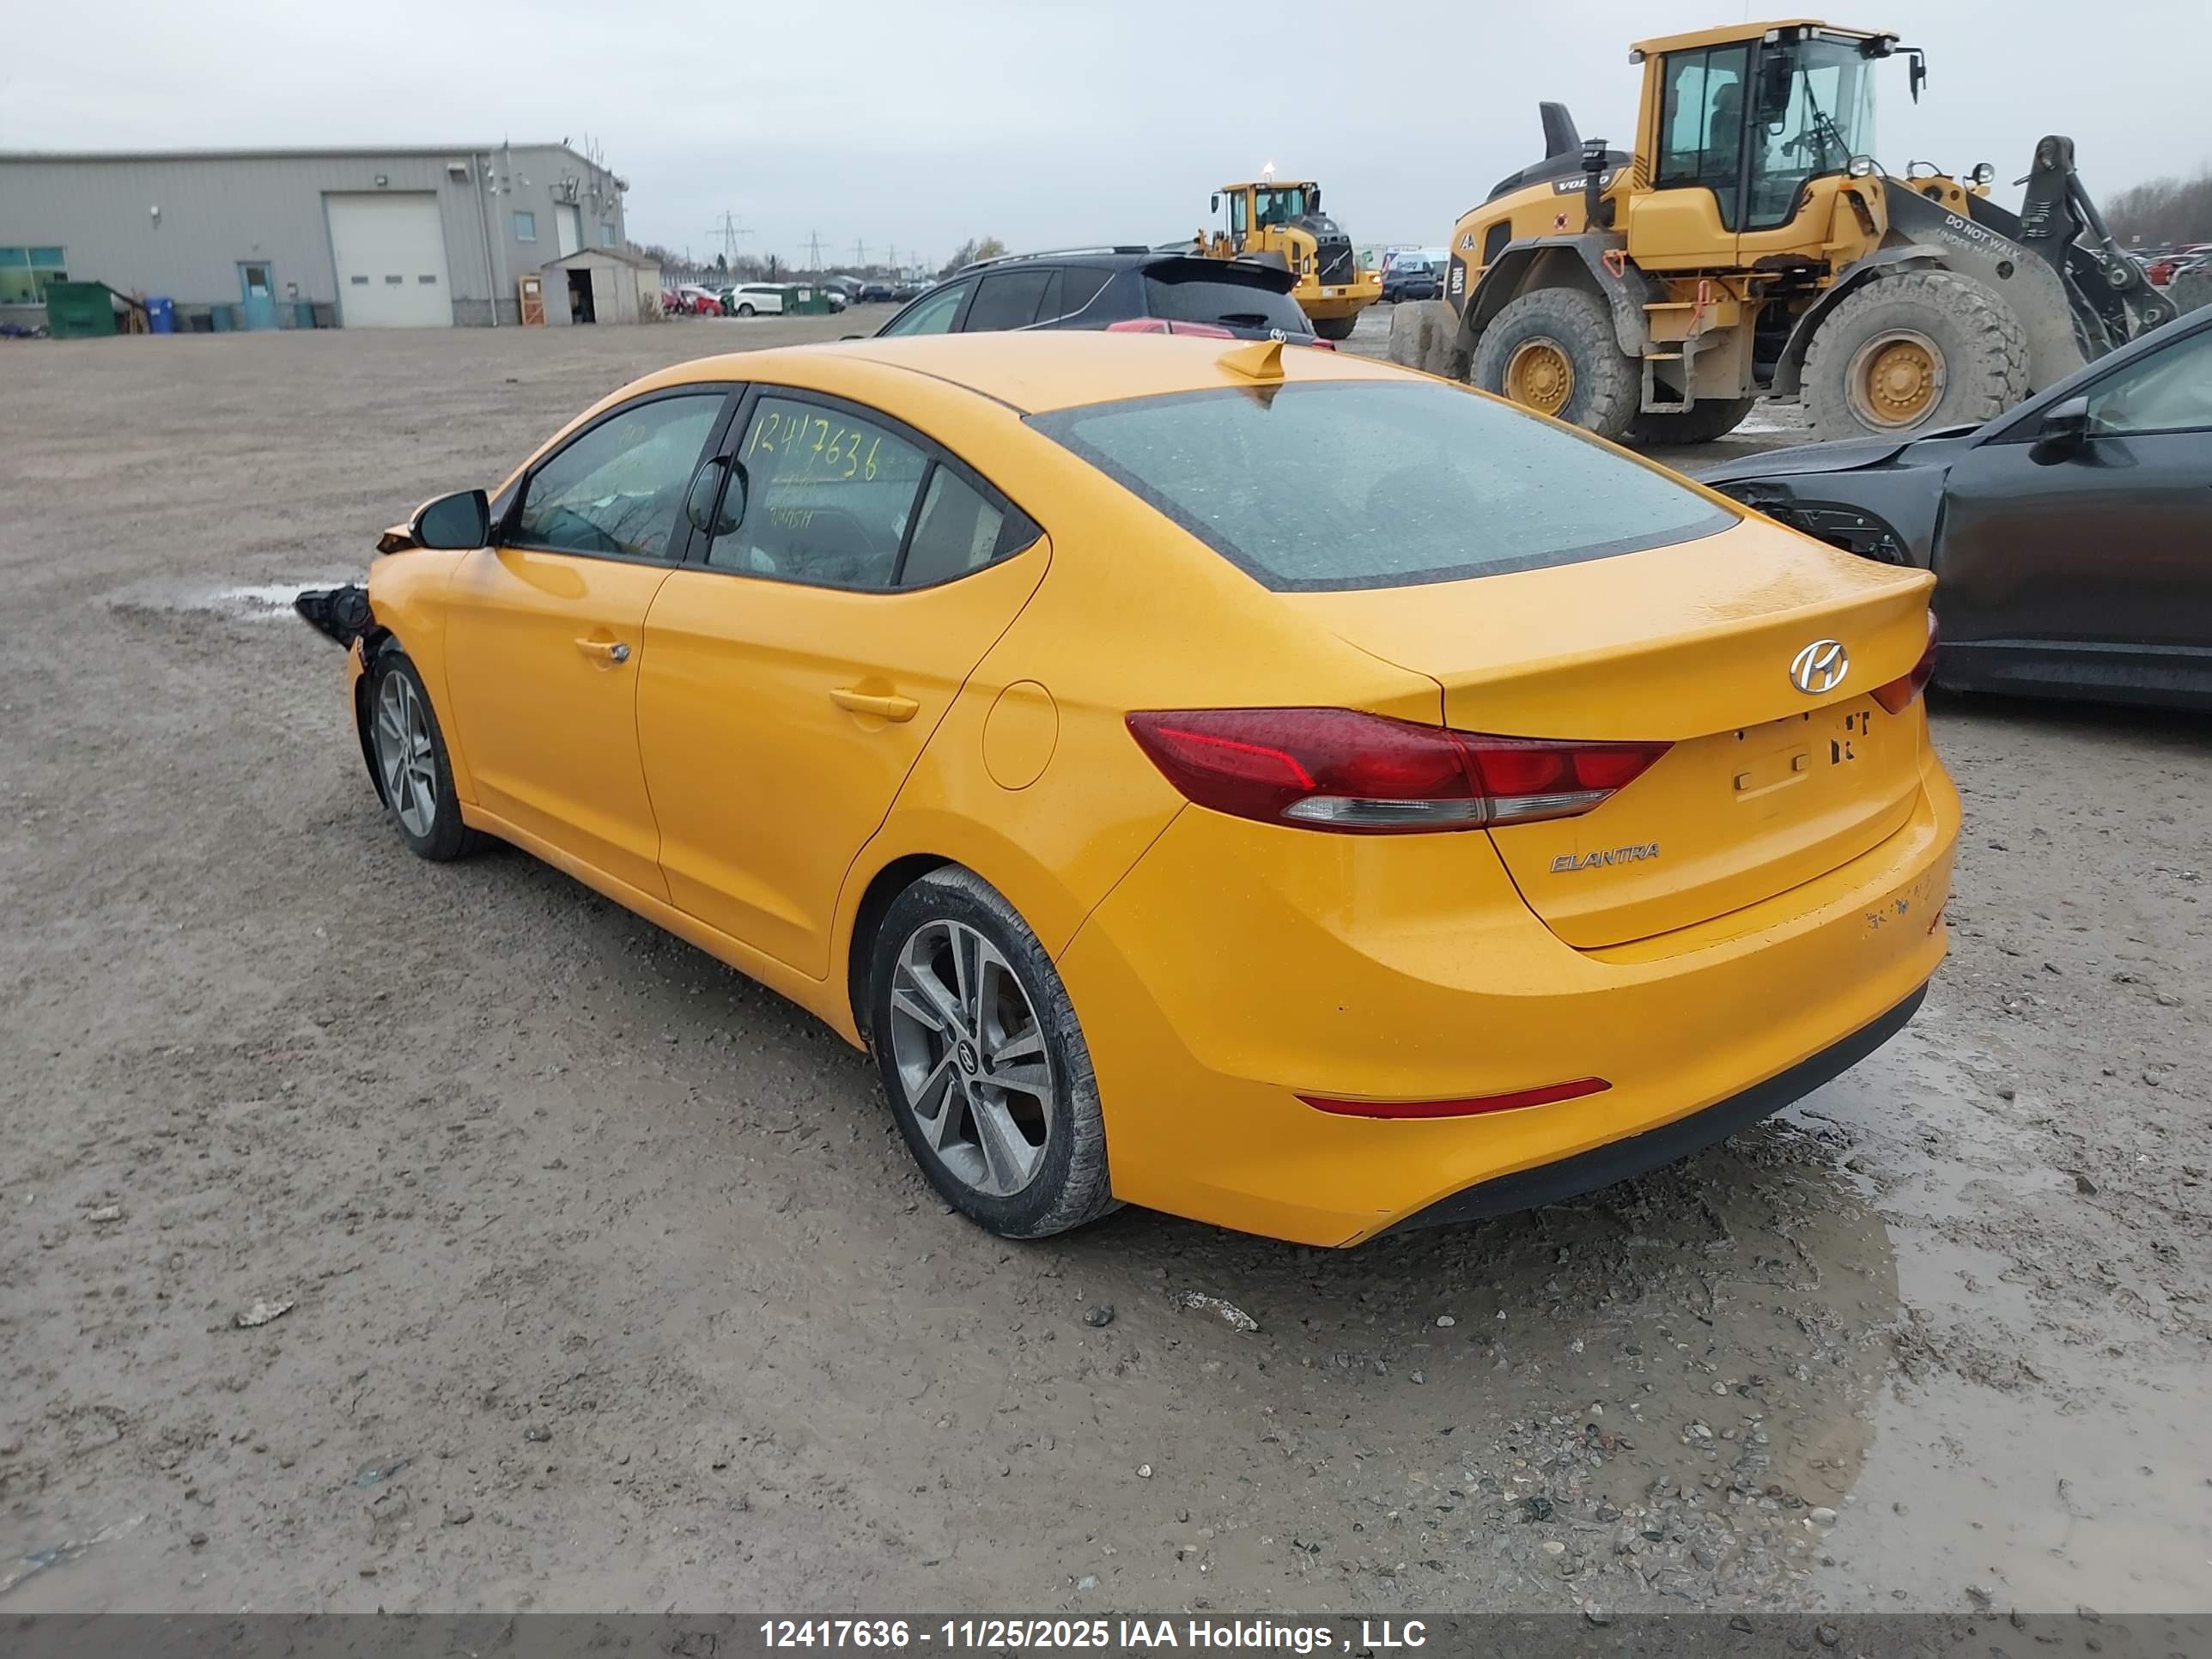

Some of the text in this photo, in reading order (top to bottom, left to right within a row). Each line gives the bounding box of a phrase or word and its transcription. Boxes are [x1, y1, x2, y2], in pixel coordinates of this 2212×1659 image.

[1558, 175, 1610, 191] VOLO
[1936, 228, 1972, 251] UNDER
[1945, 215, 2021, 258] DO NOT WALK
[1451, 267, 1463, 294] L90H
[748, 412, 882, 481] 12417636
[1550, 842, 1661, 872] ELANTRA
